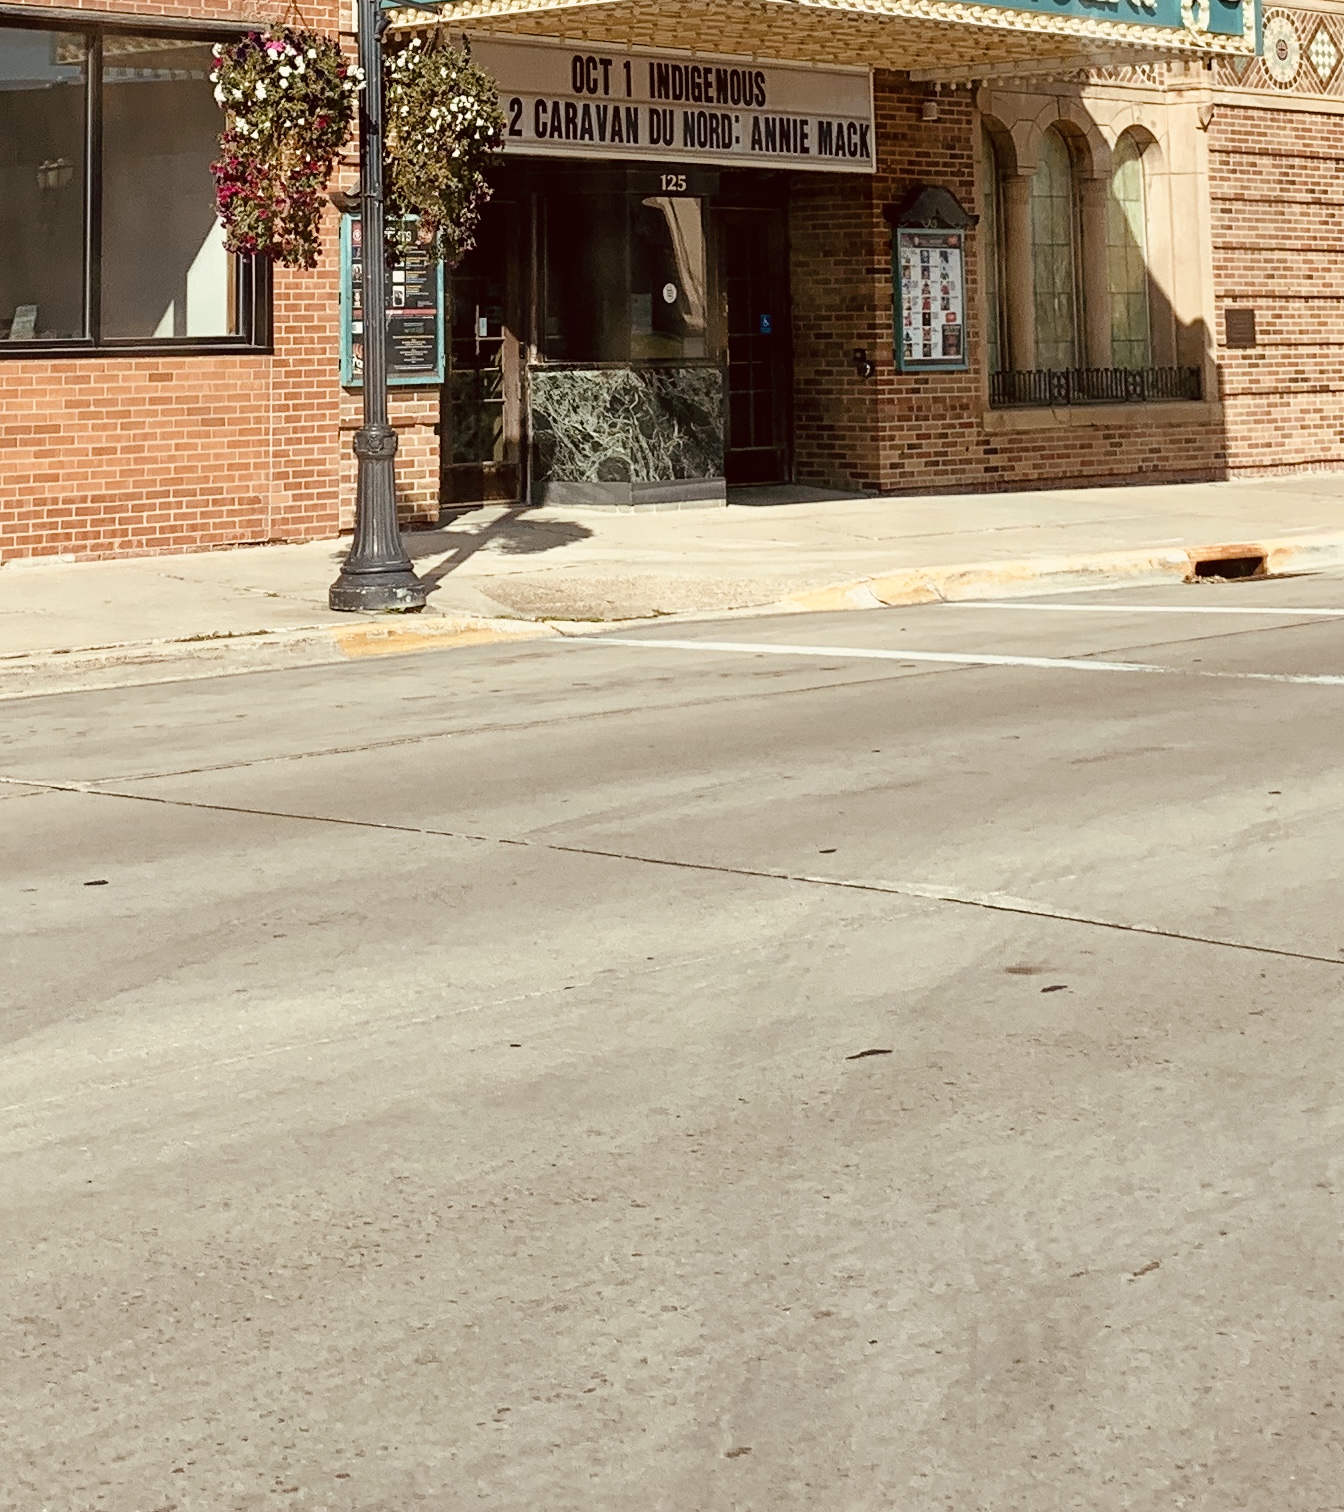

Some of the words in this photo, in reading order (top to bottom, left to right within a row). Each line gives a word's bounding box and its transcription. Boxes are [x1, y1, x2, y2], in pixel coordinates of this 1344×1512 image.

[571, 54, 613, 96] OCT
[622, 60, 632, 98] 1
[649, 61, 766, 107] INDIGENOUS
[508, 97, 523, 137] 2
[534, 98, 639, 144] CARAVAN
[649, 107, 675, 147] DU
[683, 110, 741, 150] NORD:
[751, 115, 810, 154] ANNIE
[818, 120, 871, 159] MACK
[660, 174, 687, 192] 125
